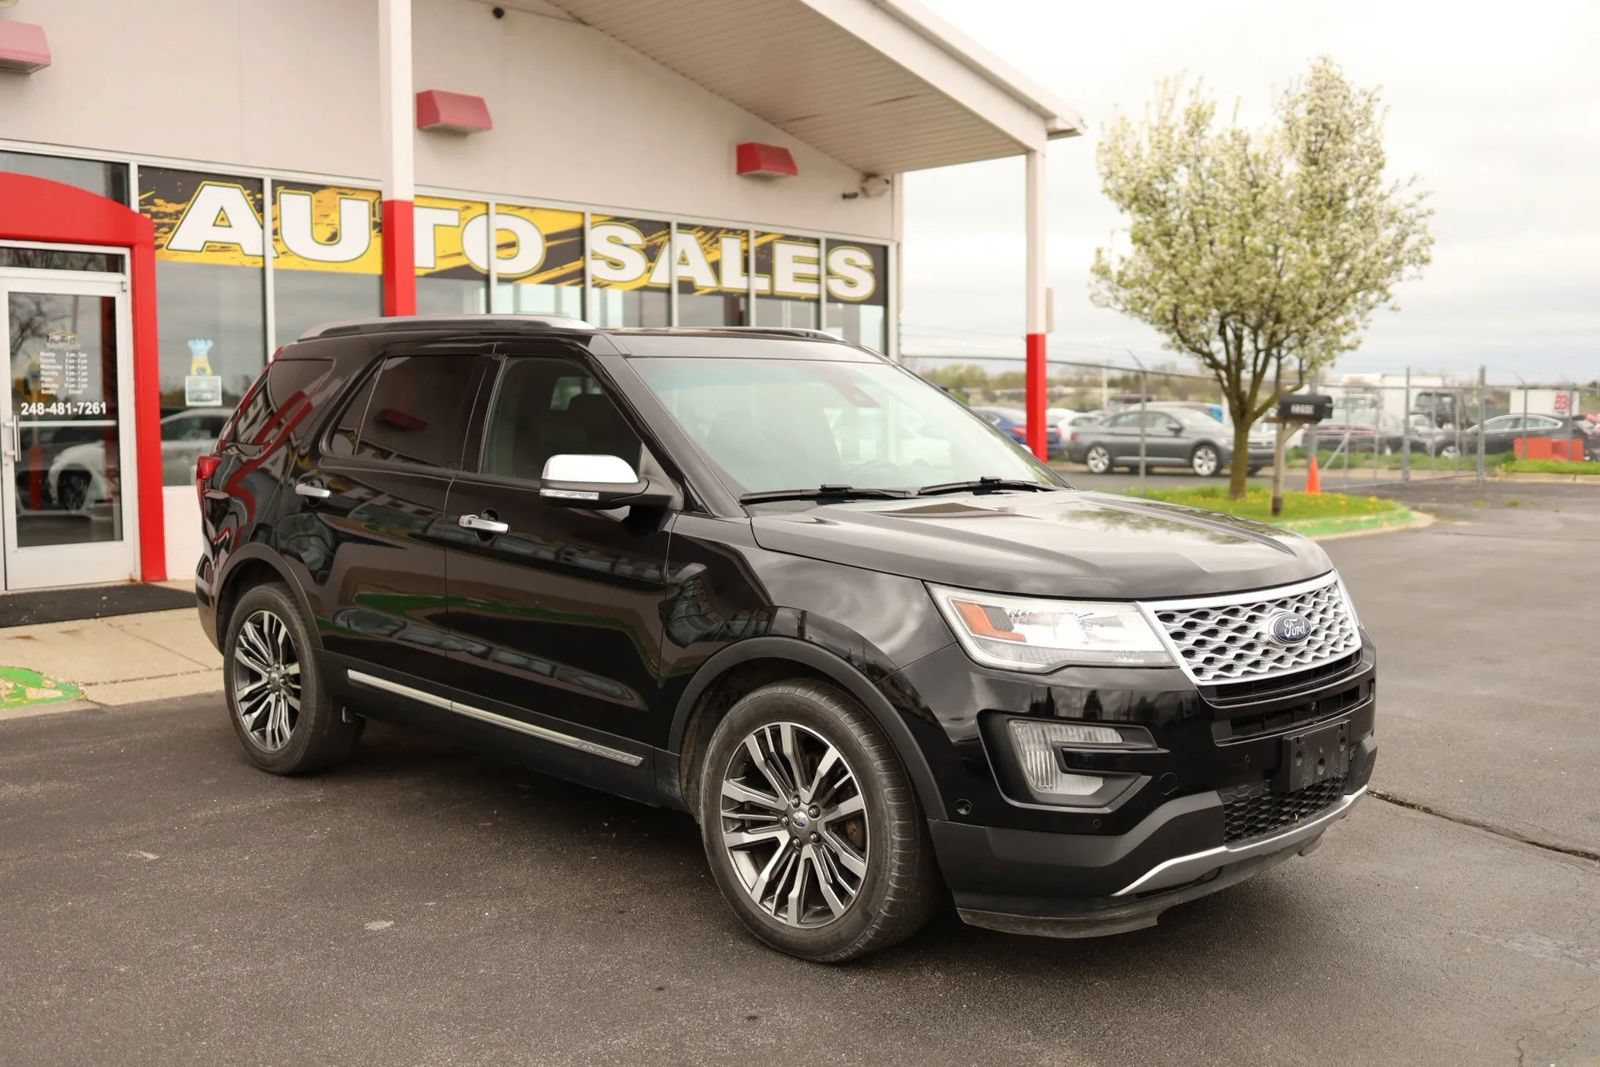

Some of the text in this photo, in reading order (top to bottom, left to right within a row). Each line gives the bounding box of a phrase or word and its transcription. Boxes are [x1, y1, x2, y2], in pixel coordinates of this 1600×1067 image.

[165, 180, 877, 301] AUTO SALES
[20, 402, 107, 416] 248-481-7261
[1283, 619, 1306, 638] Ford
